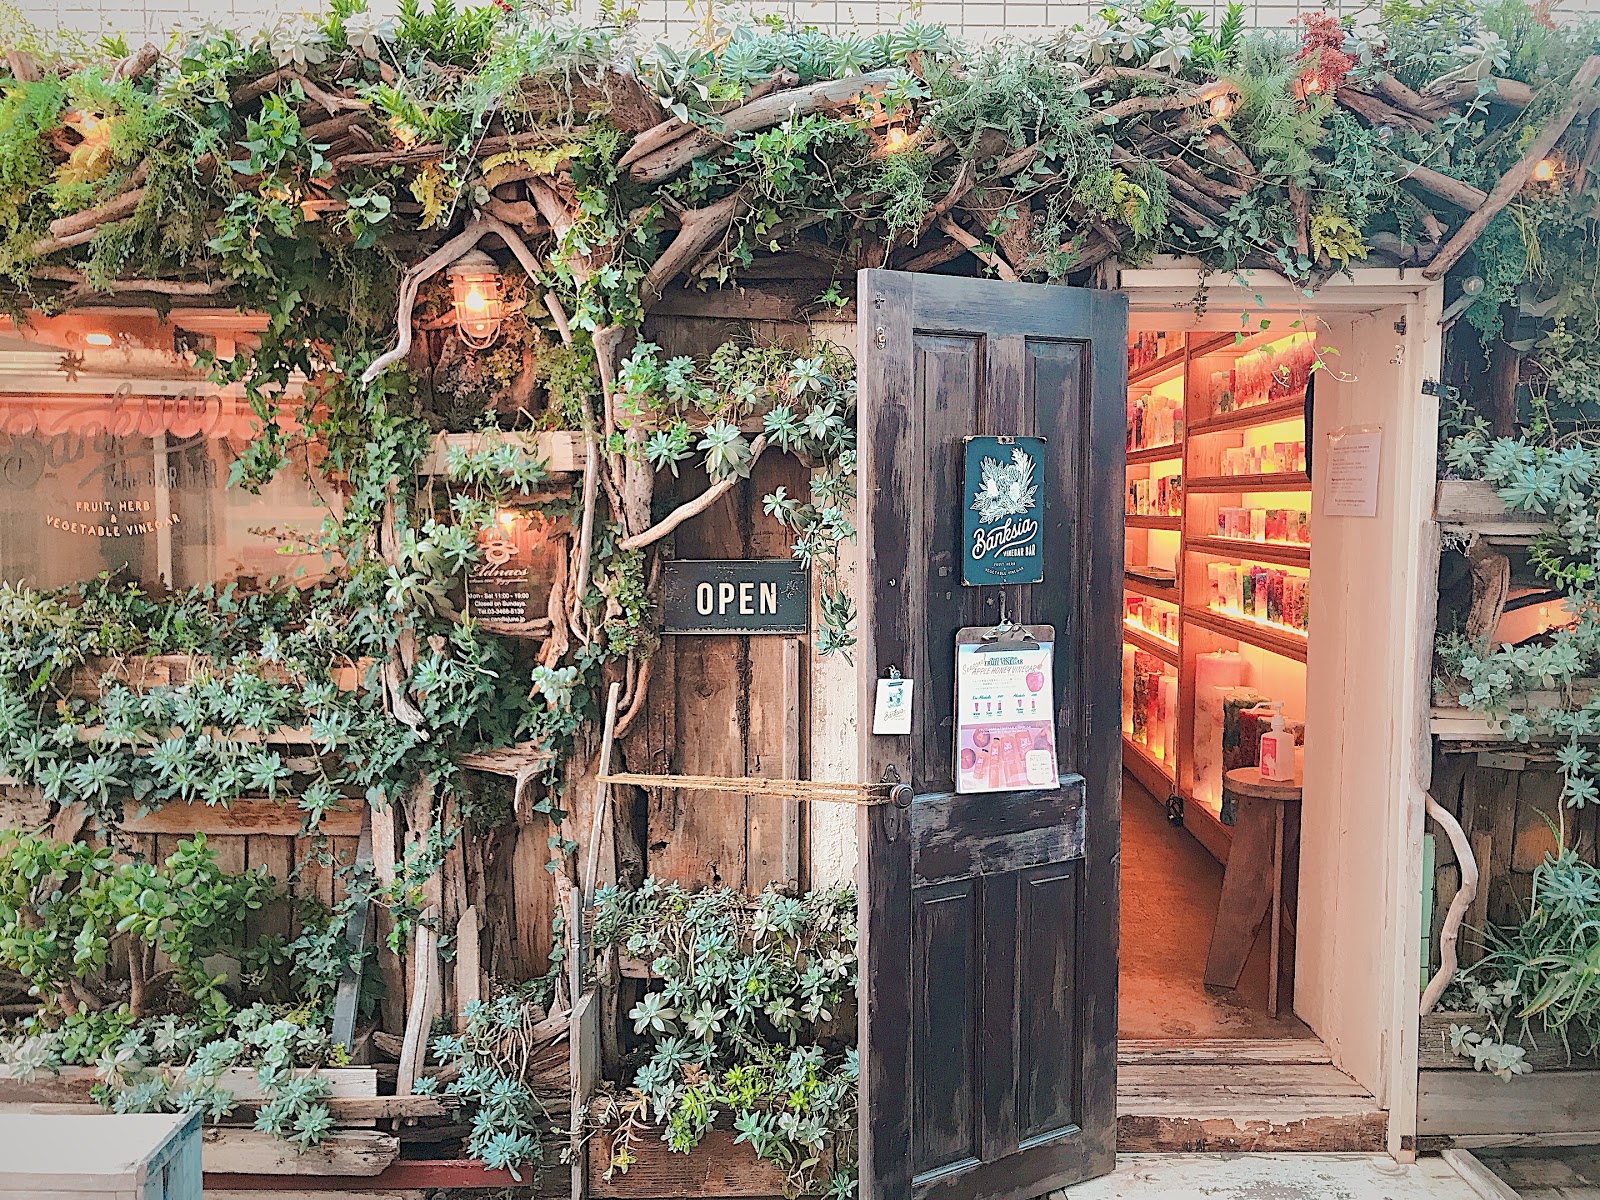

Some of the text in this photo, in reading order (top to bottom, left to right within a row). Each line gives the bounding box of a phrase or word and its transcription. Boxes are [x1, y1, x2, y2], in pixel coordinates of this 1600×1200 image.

[0, 382, 222, 490] Banksia
[119, 501, 151, 512] HERB
[46, 513, 181, 537] VEGETABLE VINEGAR
[971, 517, 1038, 560] Banksia
[1003, 544, 1036, 557] VINEGAR BAR
[696, 582, 777, 615] OPEN
[971, 664, 1037, 676] APPLE HONEY VINEGAR
[1000, 658, 1024, 666] VINEGAR
